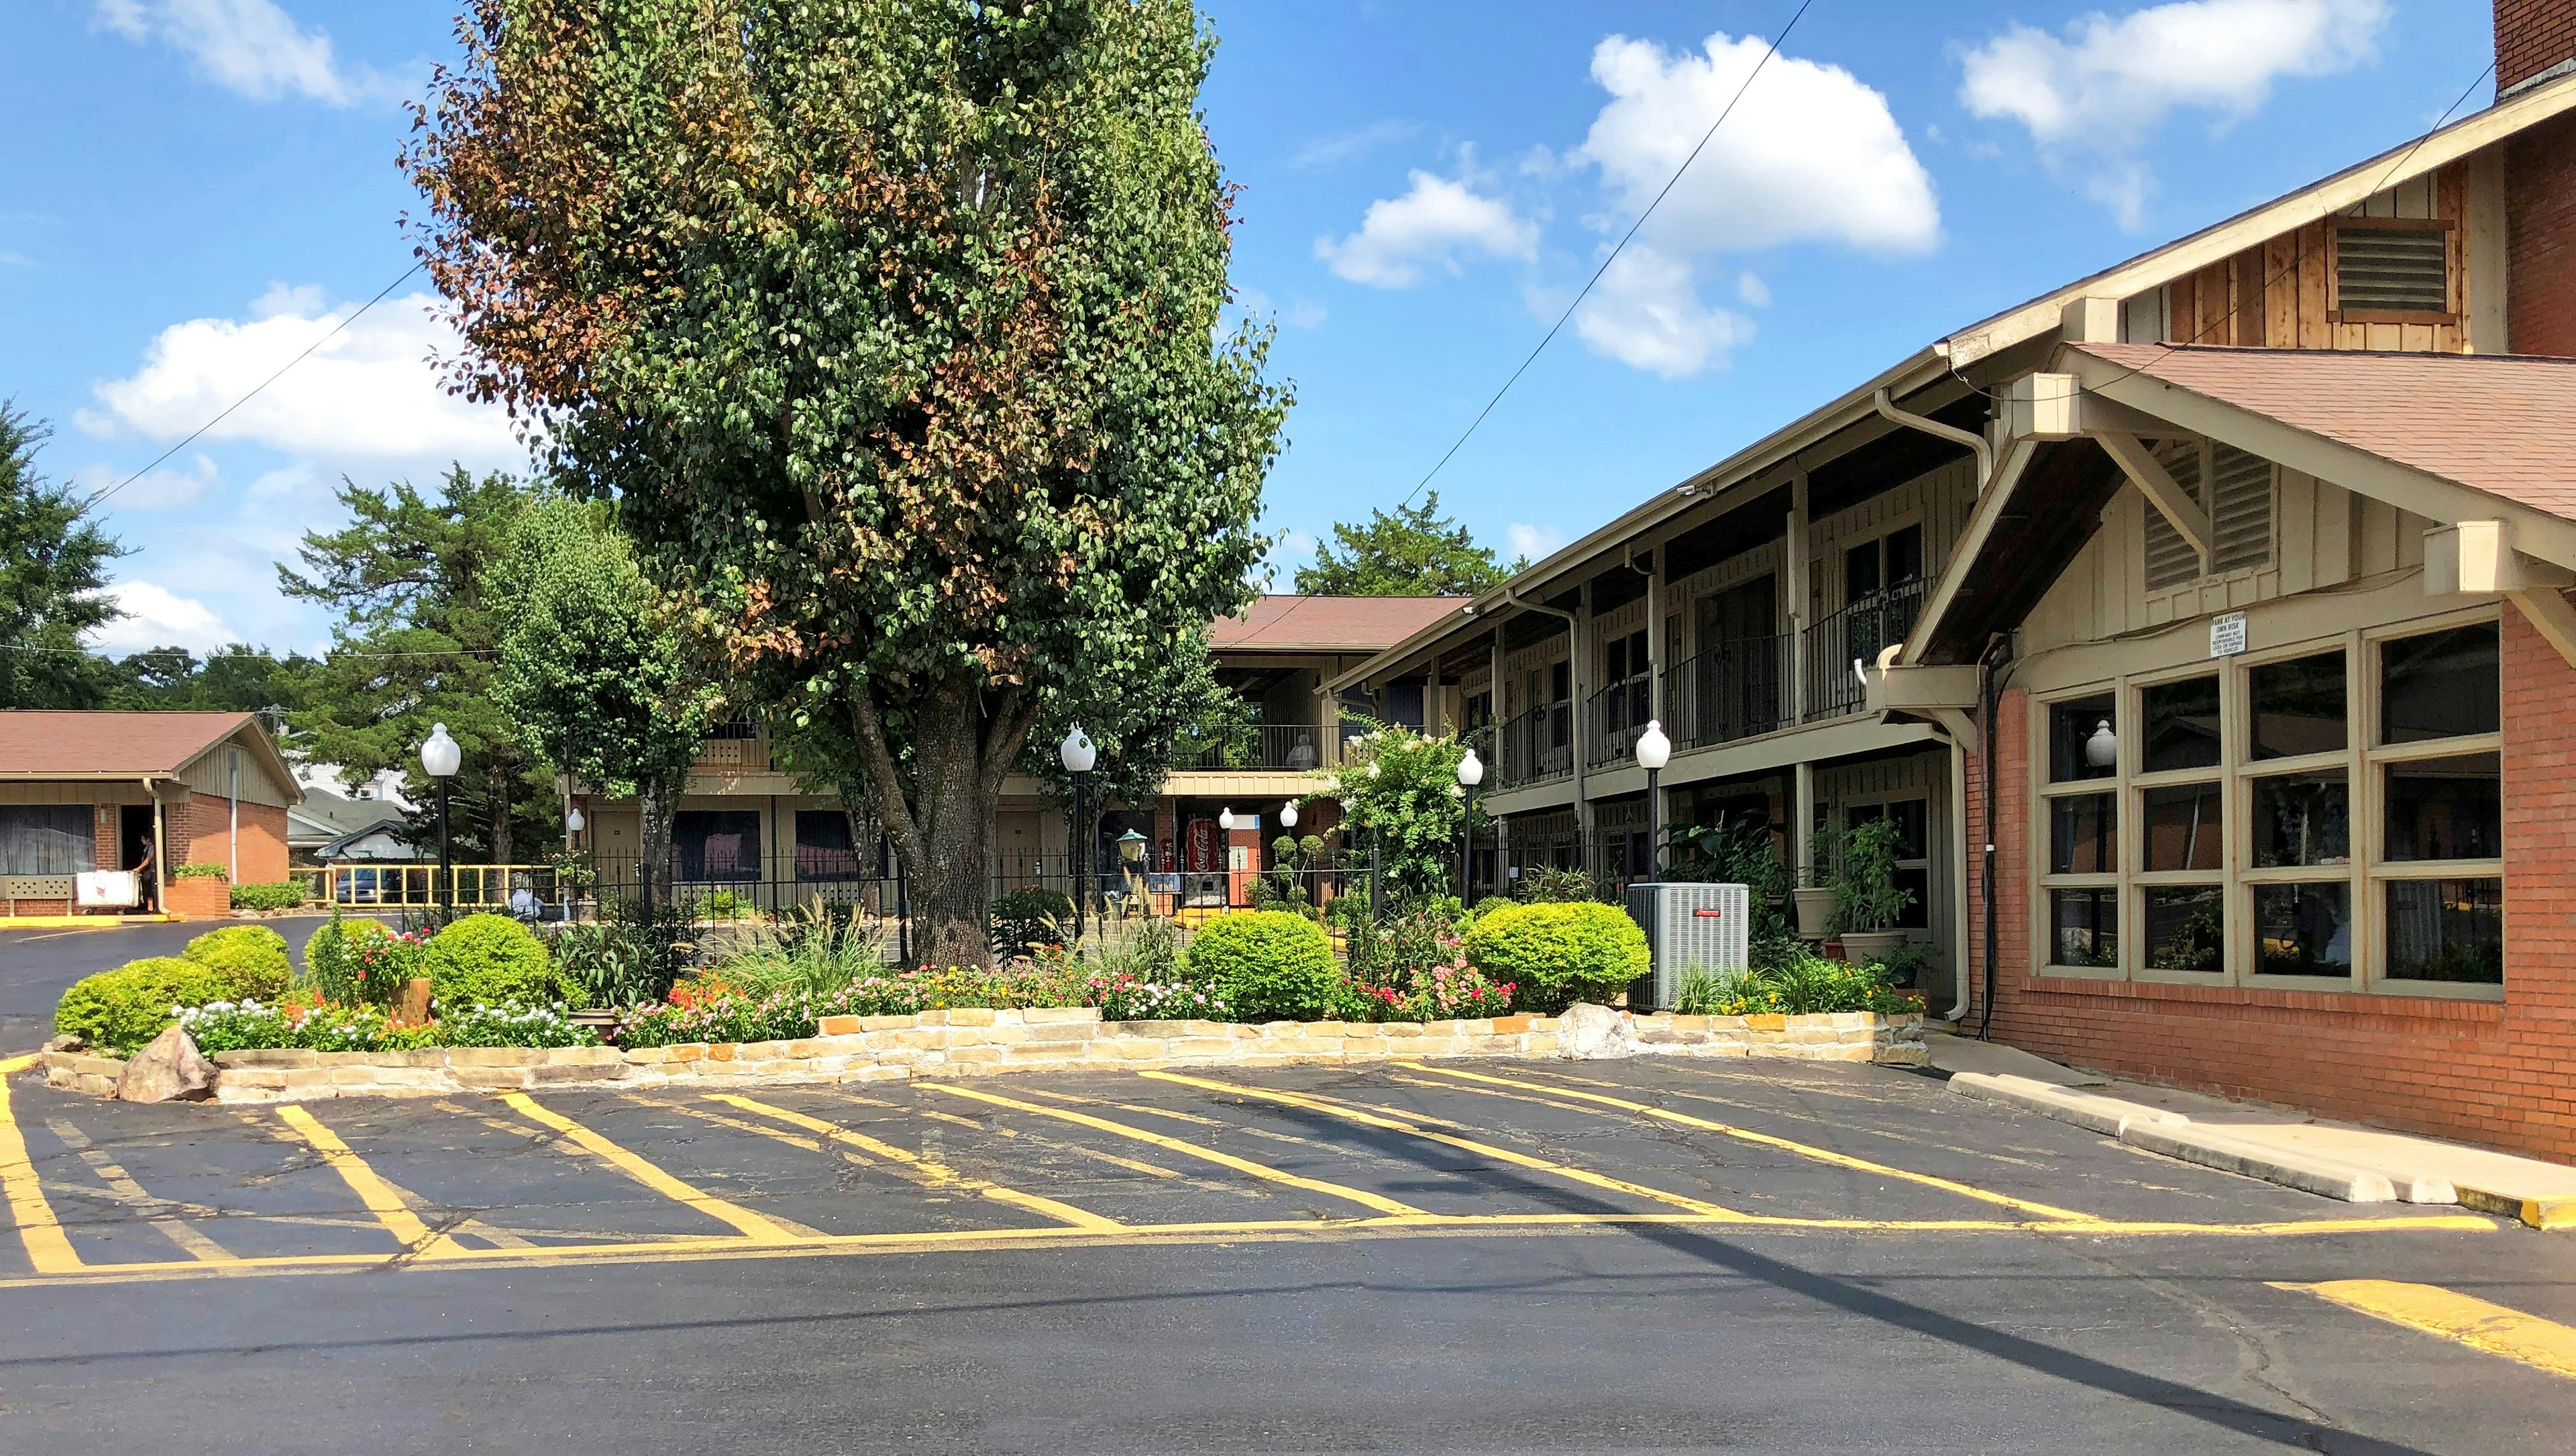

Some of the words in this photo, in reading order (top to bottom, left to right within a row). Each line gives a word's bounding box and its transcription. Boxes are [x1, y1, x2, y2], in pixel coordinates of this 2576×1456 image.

[2211, 618, 2223, 627] PARK
[2231, 613, 2245, 621] YOUR
[2228, 622, 2239, 630] RISK
[2212, 636, 2235, 645] RESPONSIBLE
